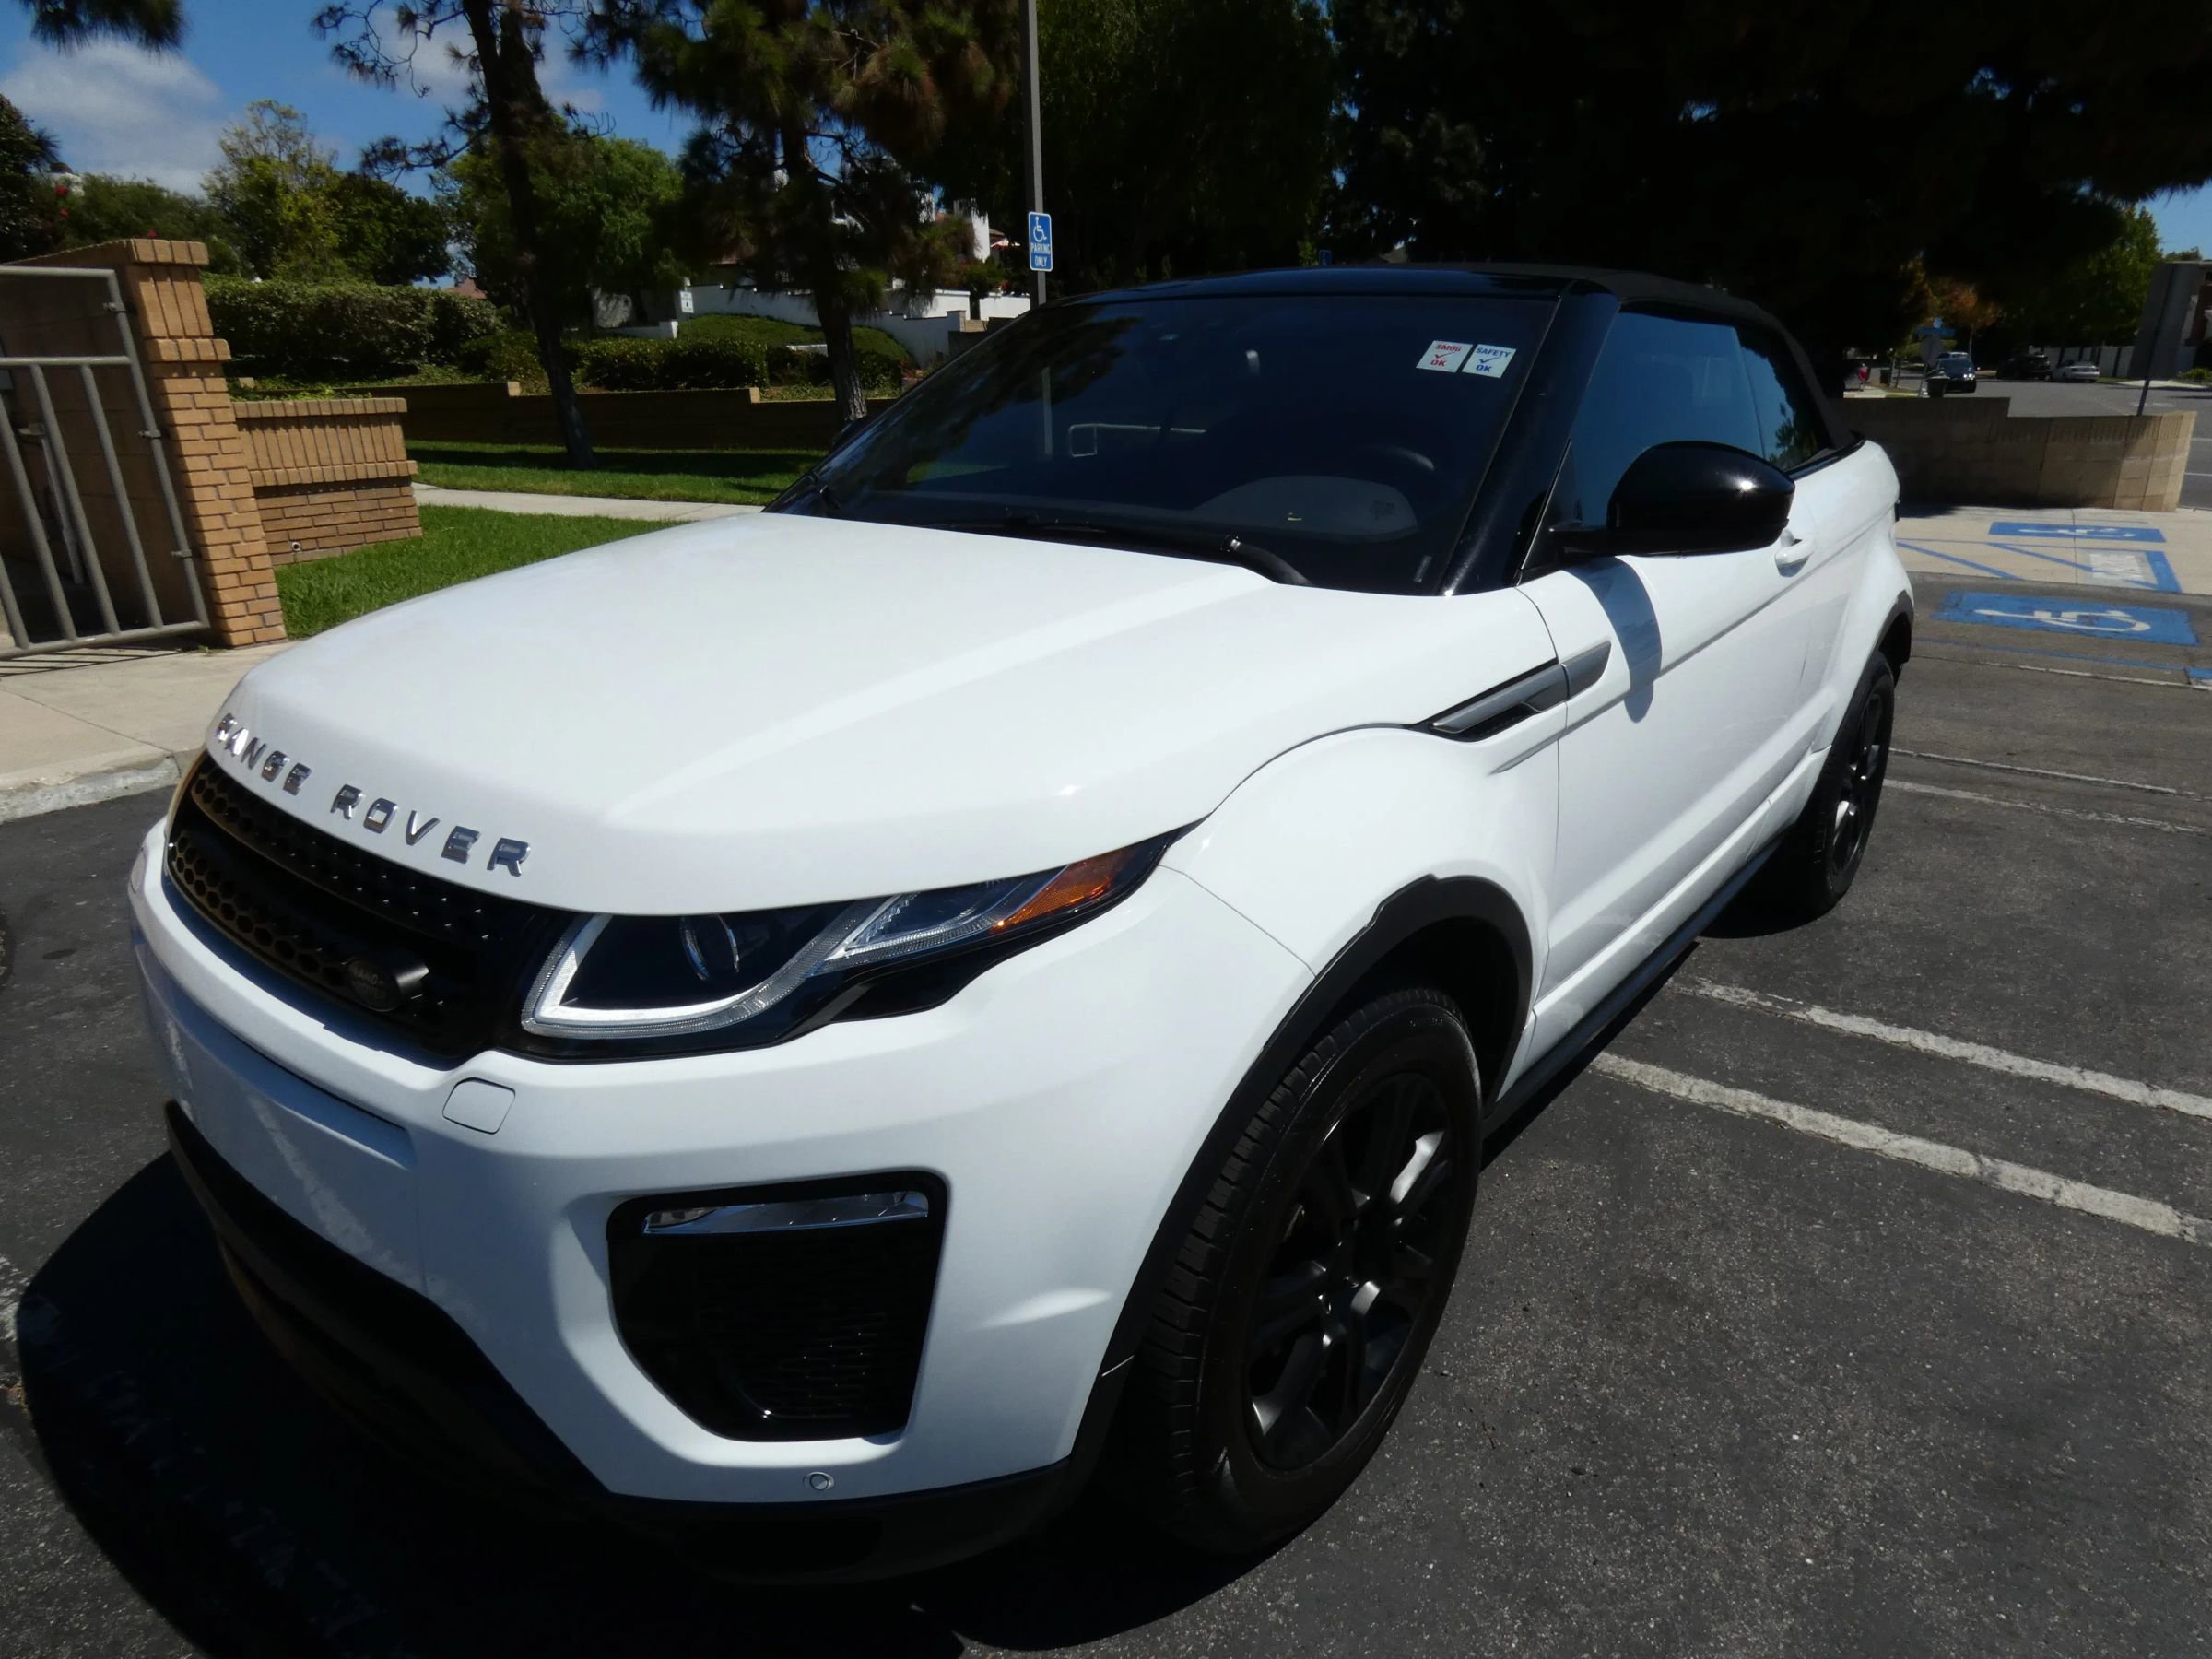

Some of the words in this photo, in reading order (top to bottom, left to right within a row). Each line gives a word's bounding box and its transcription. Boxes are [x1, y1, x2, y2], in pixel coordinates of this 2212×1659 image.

[1031, 243, 1051, 254] PARKING
[1035, 255, 1047, 267] ONLY
[1435, 344, 1462, 352] SMOG
[1476, 347, 1511, 358] SAFETY
[1476, 364, 1491, 372] OK
[215, 712, 312, 796] RANGE
[330, 783, 532, 877] ROVER
